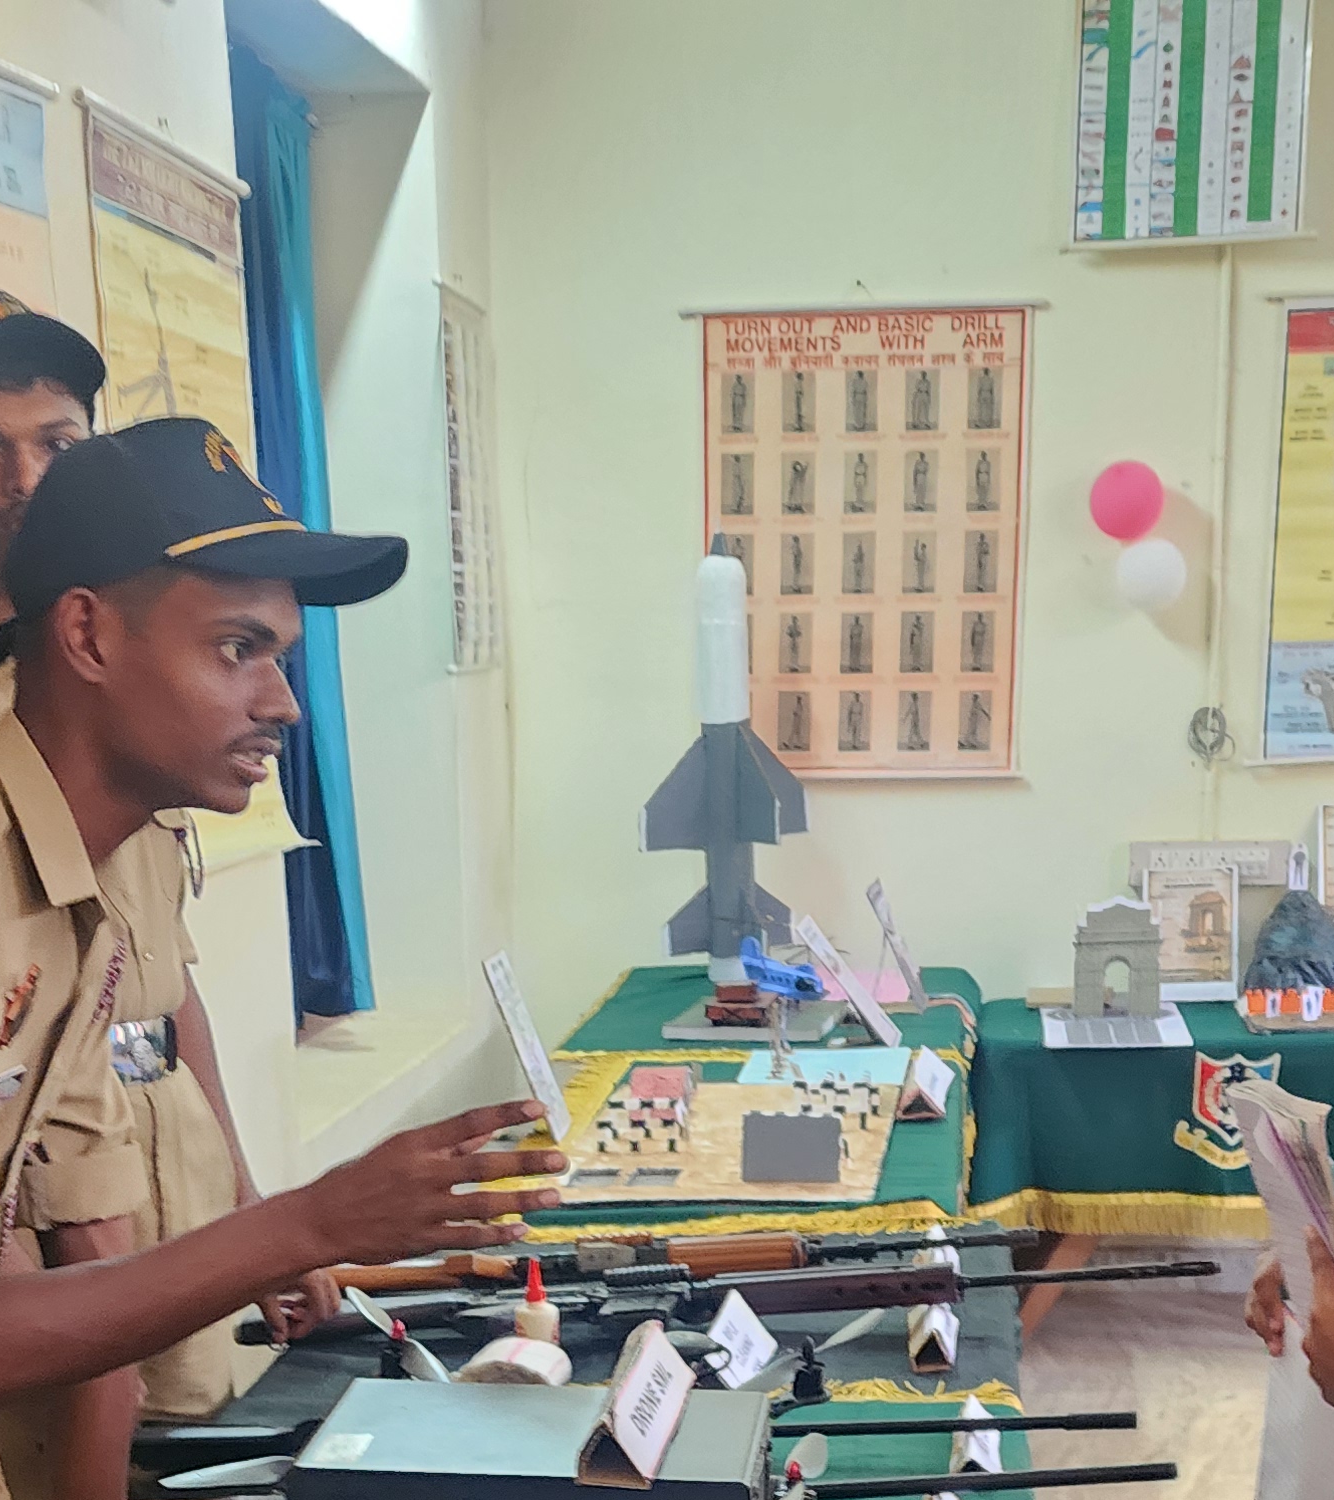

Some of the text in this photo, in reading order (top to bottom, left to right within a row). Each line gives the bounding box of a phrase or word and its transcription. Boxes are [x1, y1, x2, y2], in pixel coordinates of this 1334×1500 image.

[722, 313, 1005, 337] TURN OUT AND BASIC DRILL
[726, 331, 1004, 353] MOVEMENTS WITH ARM
[629, 1381, 662, 1438] DRONE
